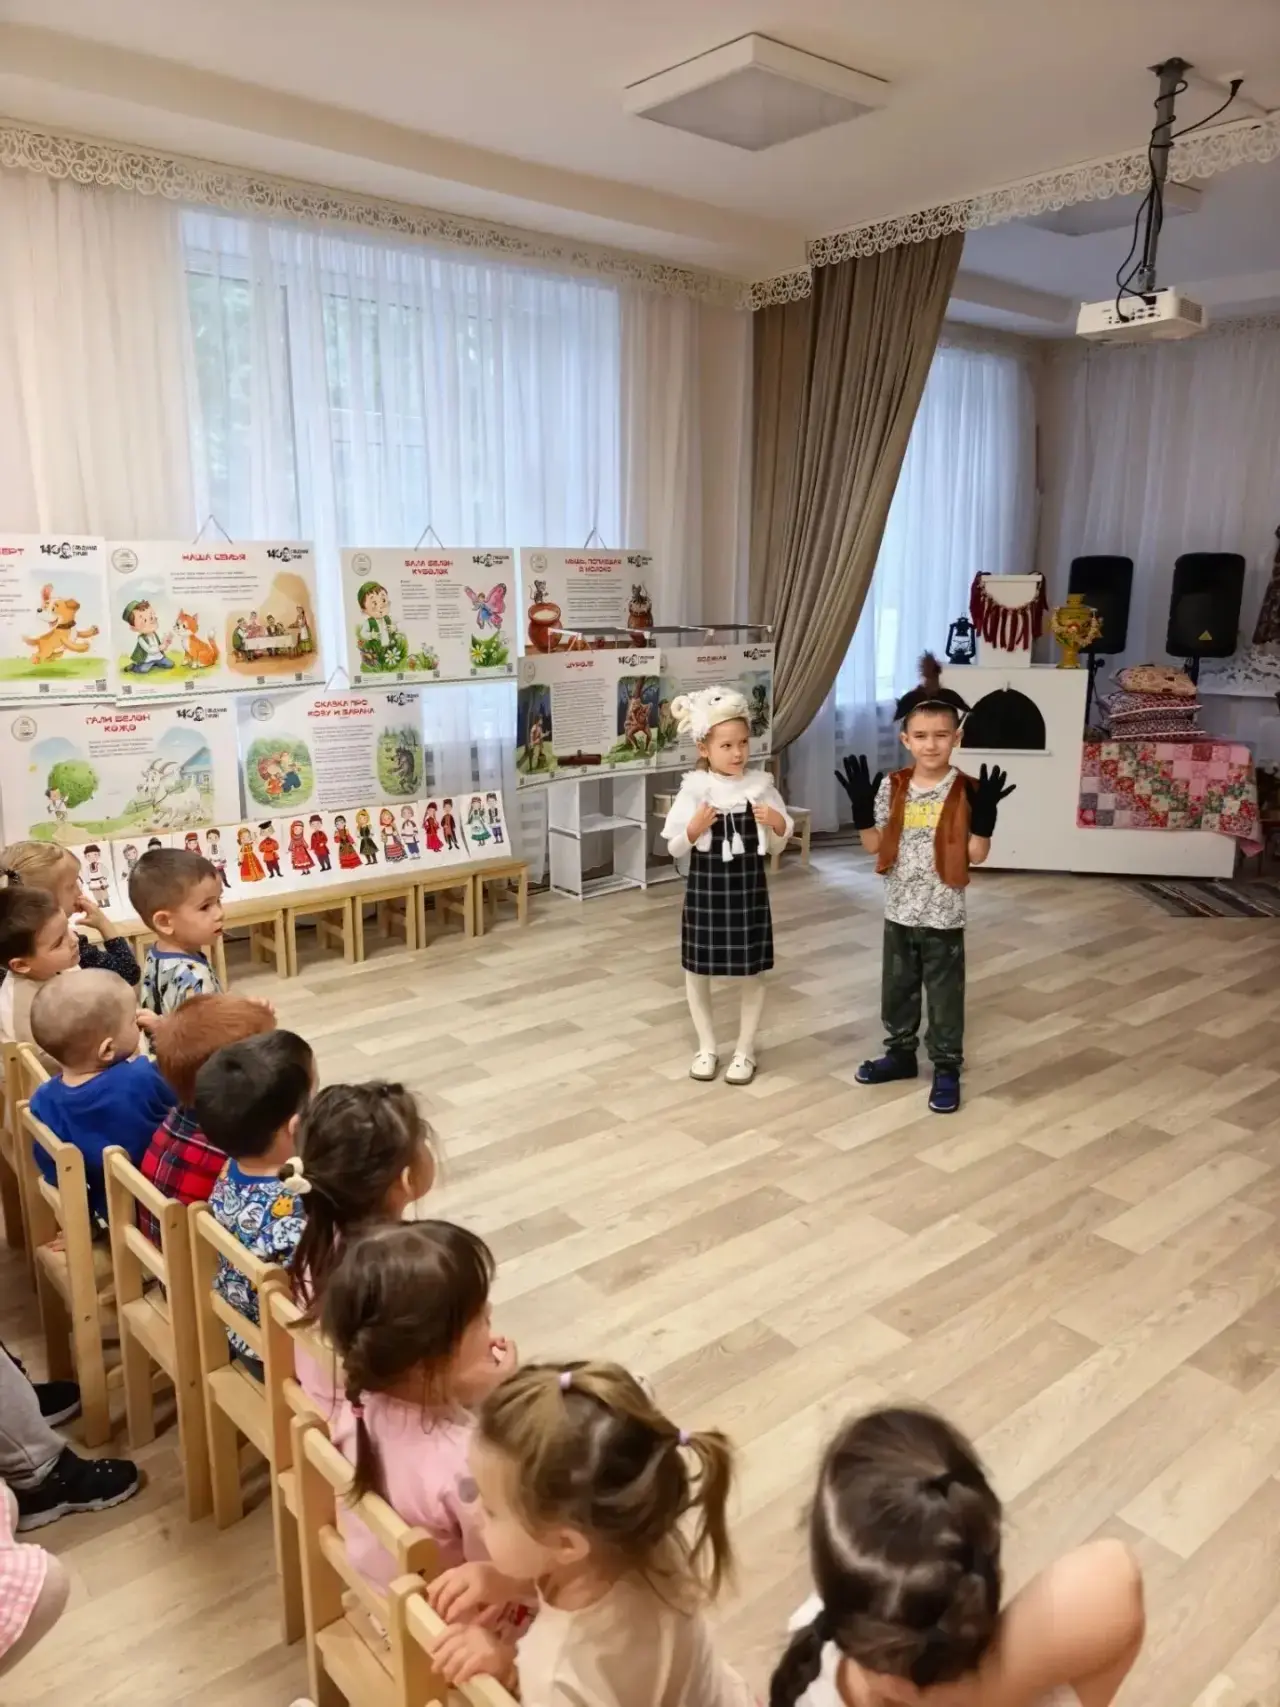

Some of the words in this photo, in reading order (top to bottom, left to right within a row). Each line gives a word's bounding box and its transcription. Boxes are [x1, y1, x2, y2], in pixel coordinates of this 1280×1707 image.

[182, 552, 212, 560] НАША
[314, 700, 349, 708] СКАЗКА
[350, 699, 368, 707] ПРО
[307, 709, 332, 717] КОЗУ
[342, 708, 375, 716] БАРАНА
[85, 716, 113, 725] ГАЛИ
